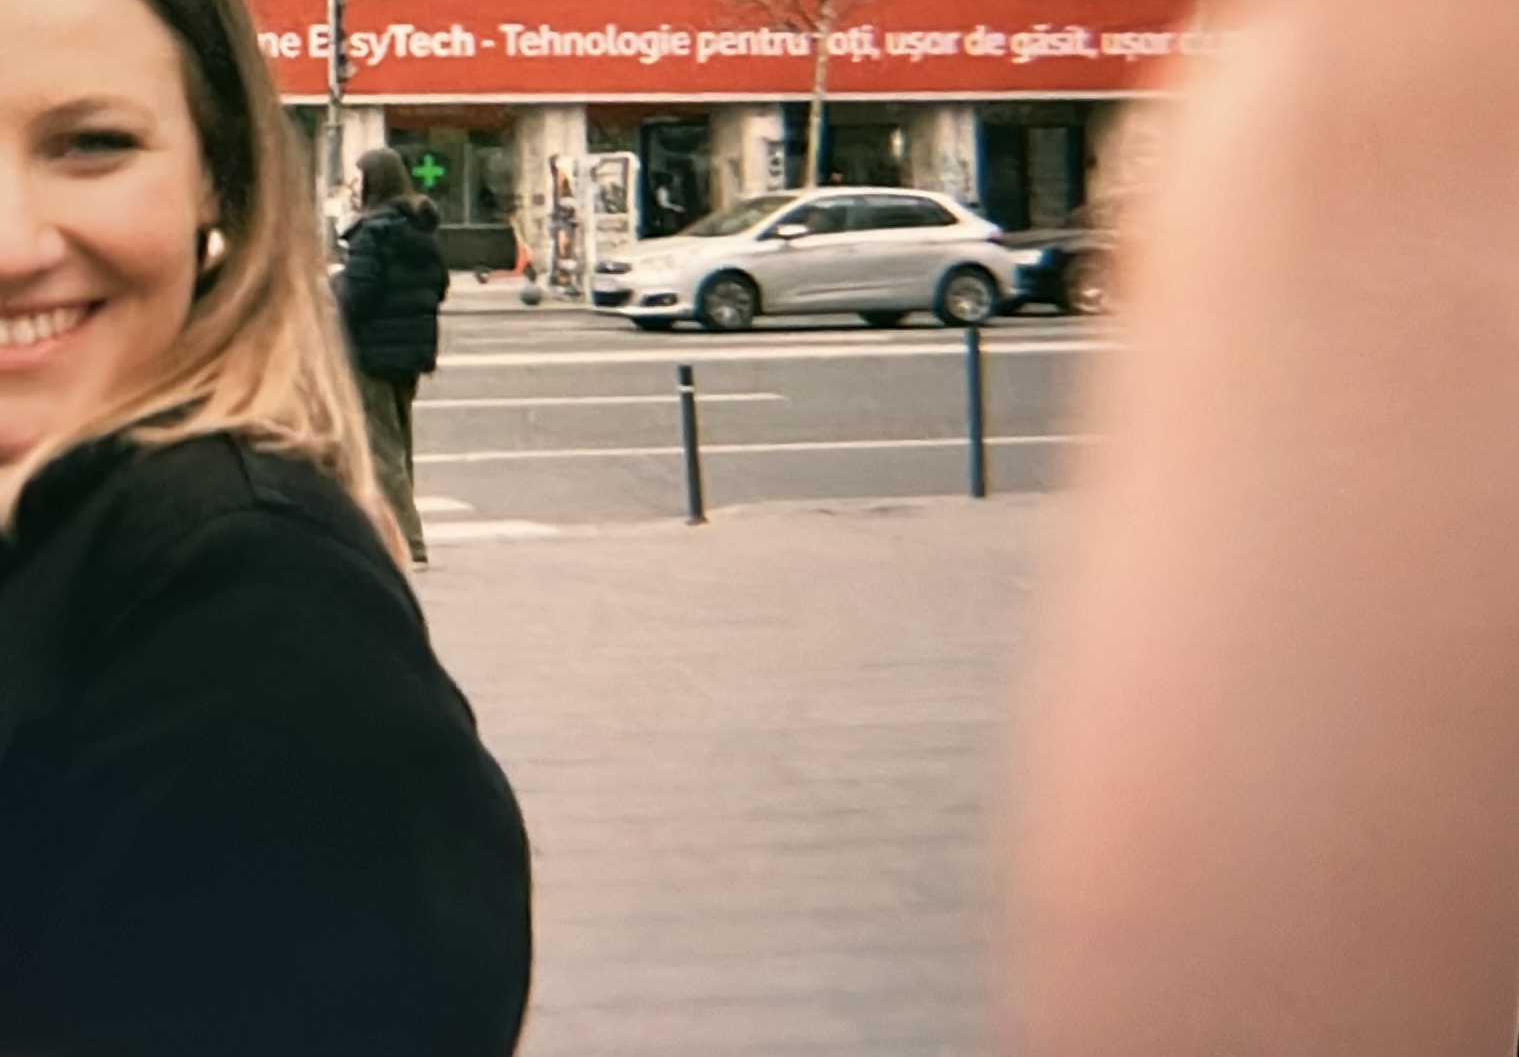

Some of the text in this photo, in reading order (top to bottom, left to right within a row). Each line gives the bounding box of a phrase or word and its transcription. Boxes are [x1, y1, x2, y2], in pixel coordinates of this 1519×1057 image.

[309, 23, 475, 66] EsyTech
[498, 23, 692, 65] Tehnologie
[696, 28, 811, 63] pentru
[885, 30, 960, 63] ușor
[964, 25, 1006, 56] de
